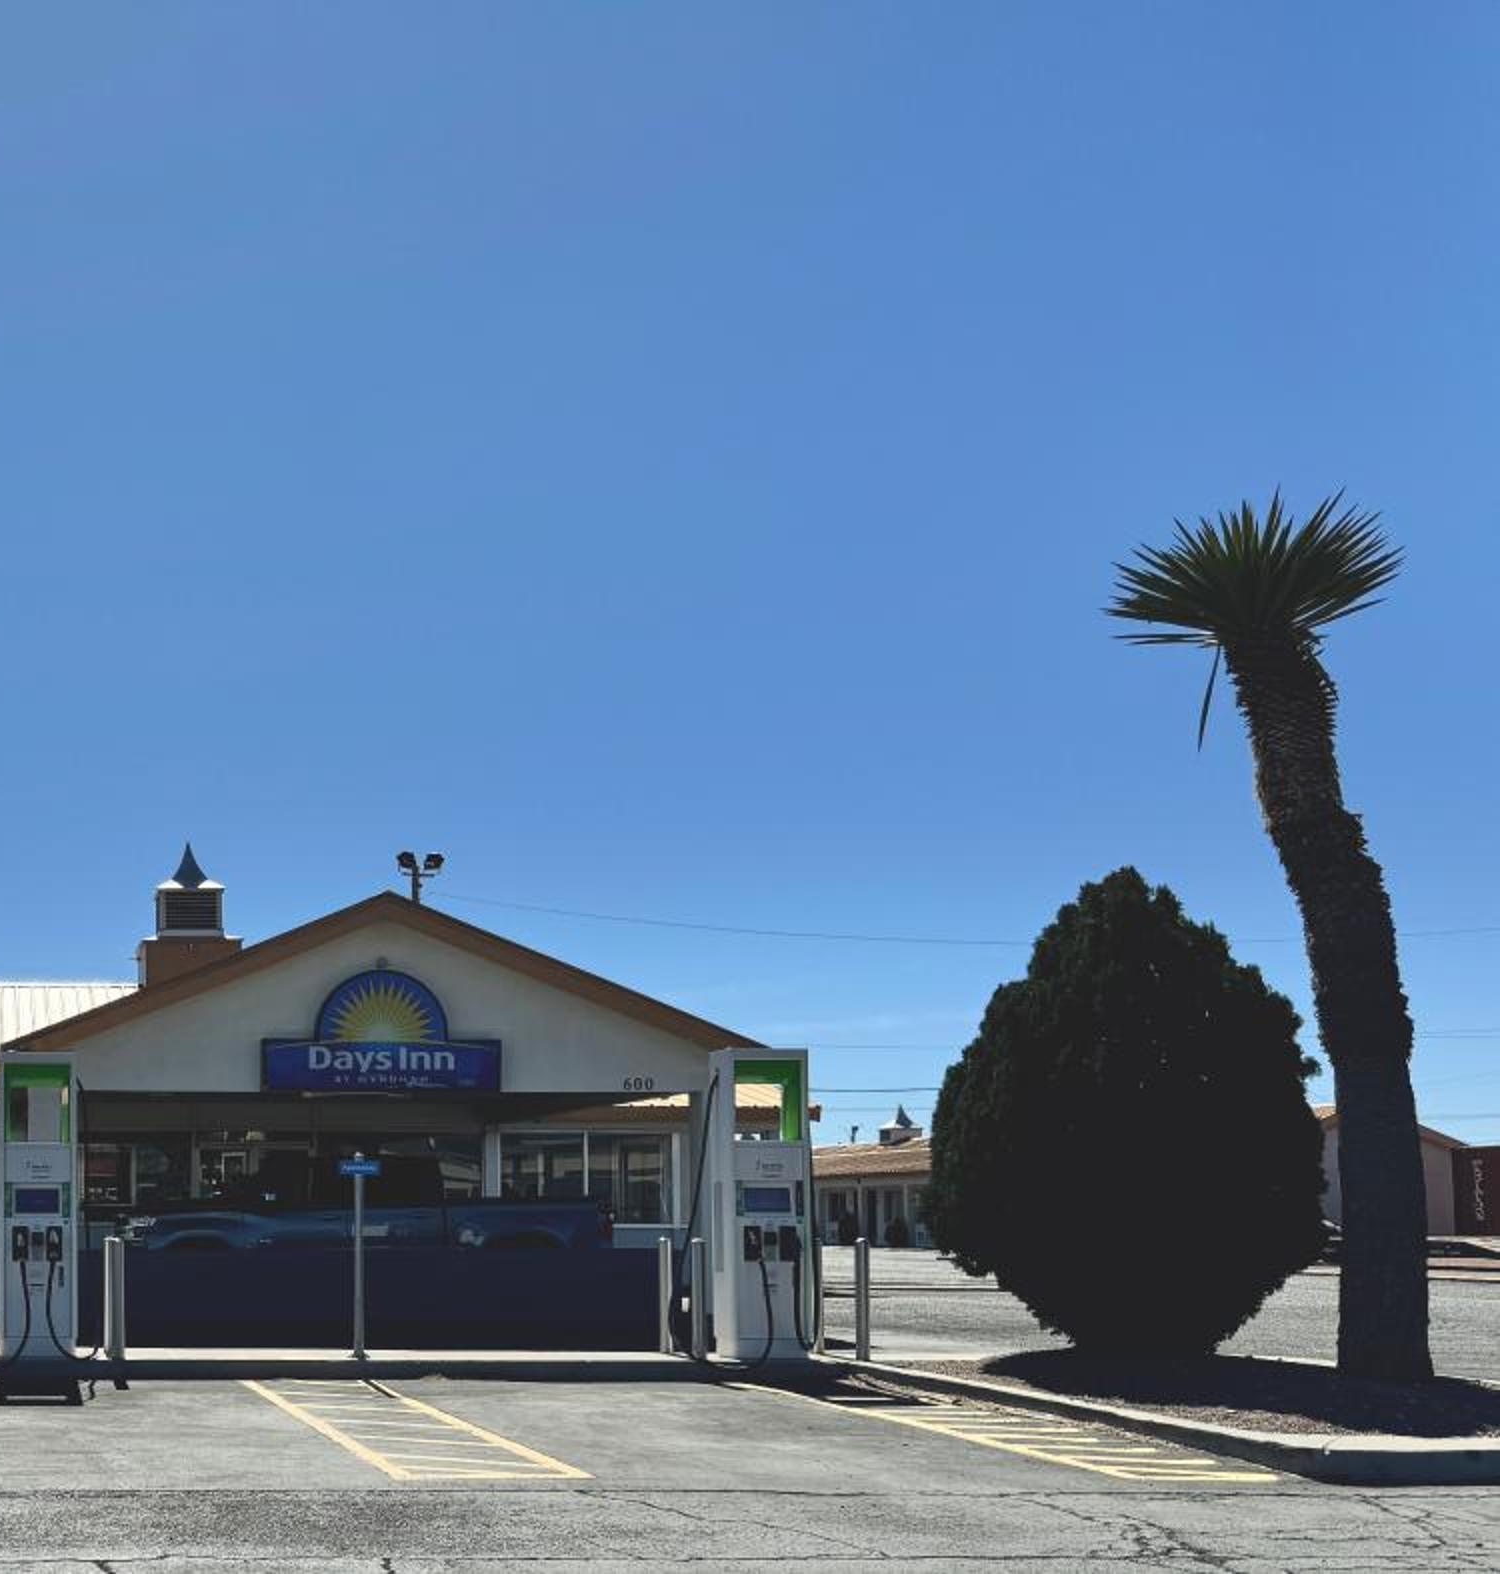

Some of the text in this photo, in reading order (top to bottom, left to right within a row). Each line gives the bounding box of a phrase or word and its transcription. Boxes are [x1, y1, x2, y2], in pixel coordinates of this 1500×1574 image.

[308, 1045, 455, 1073] Days Inn
[623, 1077, 653, 1090] 600
